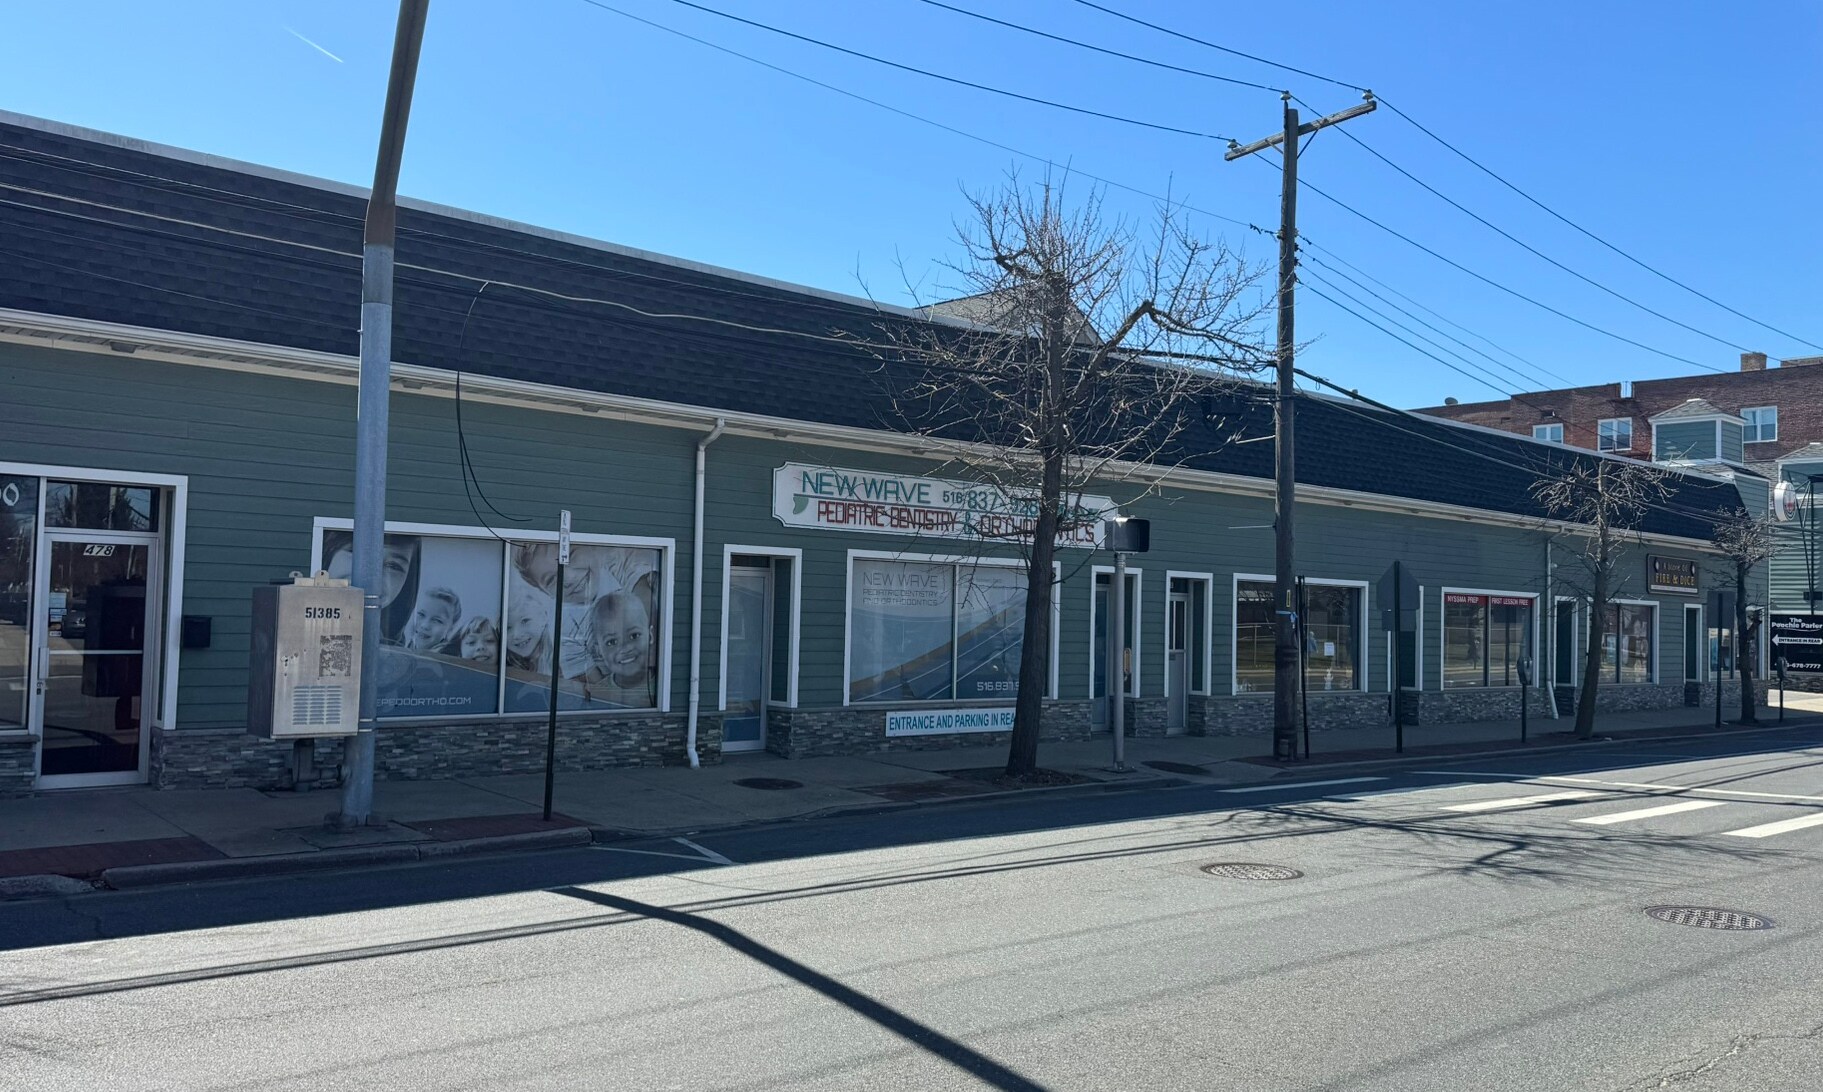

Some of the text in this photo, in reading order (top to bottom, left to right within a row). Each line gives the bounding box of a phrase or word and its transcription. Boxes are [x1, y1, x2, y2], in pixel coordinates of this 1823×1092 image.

[802, 471, 857, 497] NEW
[862, 477, 932, 504] WAVE
[943, 490, 963, 504] 516
[817, 500, 885, 527] PEDIATRIC
[890, 507, 958, 532] DENTISTRY
[86, 544, 114, 556] 478
[863, 571, 938, 588] NEW WAVE
[1655, 572, 1670, 584] FIRE
[1680, 575, 1695, 586] DICE
[1447, 595, 1479, 604] NYSSMA PREP
[304, 606, 341, 619] 51385
[976, 681, 1020, 692] 516.837.9
[889, 712, 1015, 731] ENTRANCE AND PARKING IN REA
